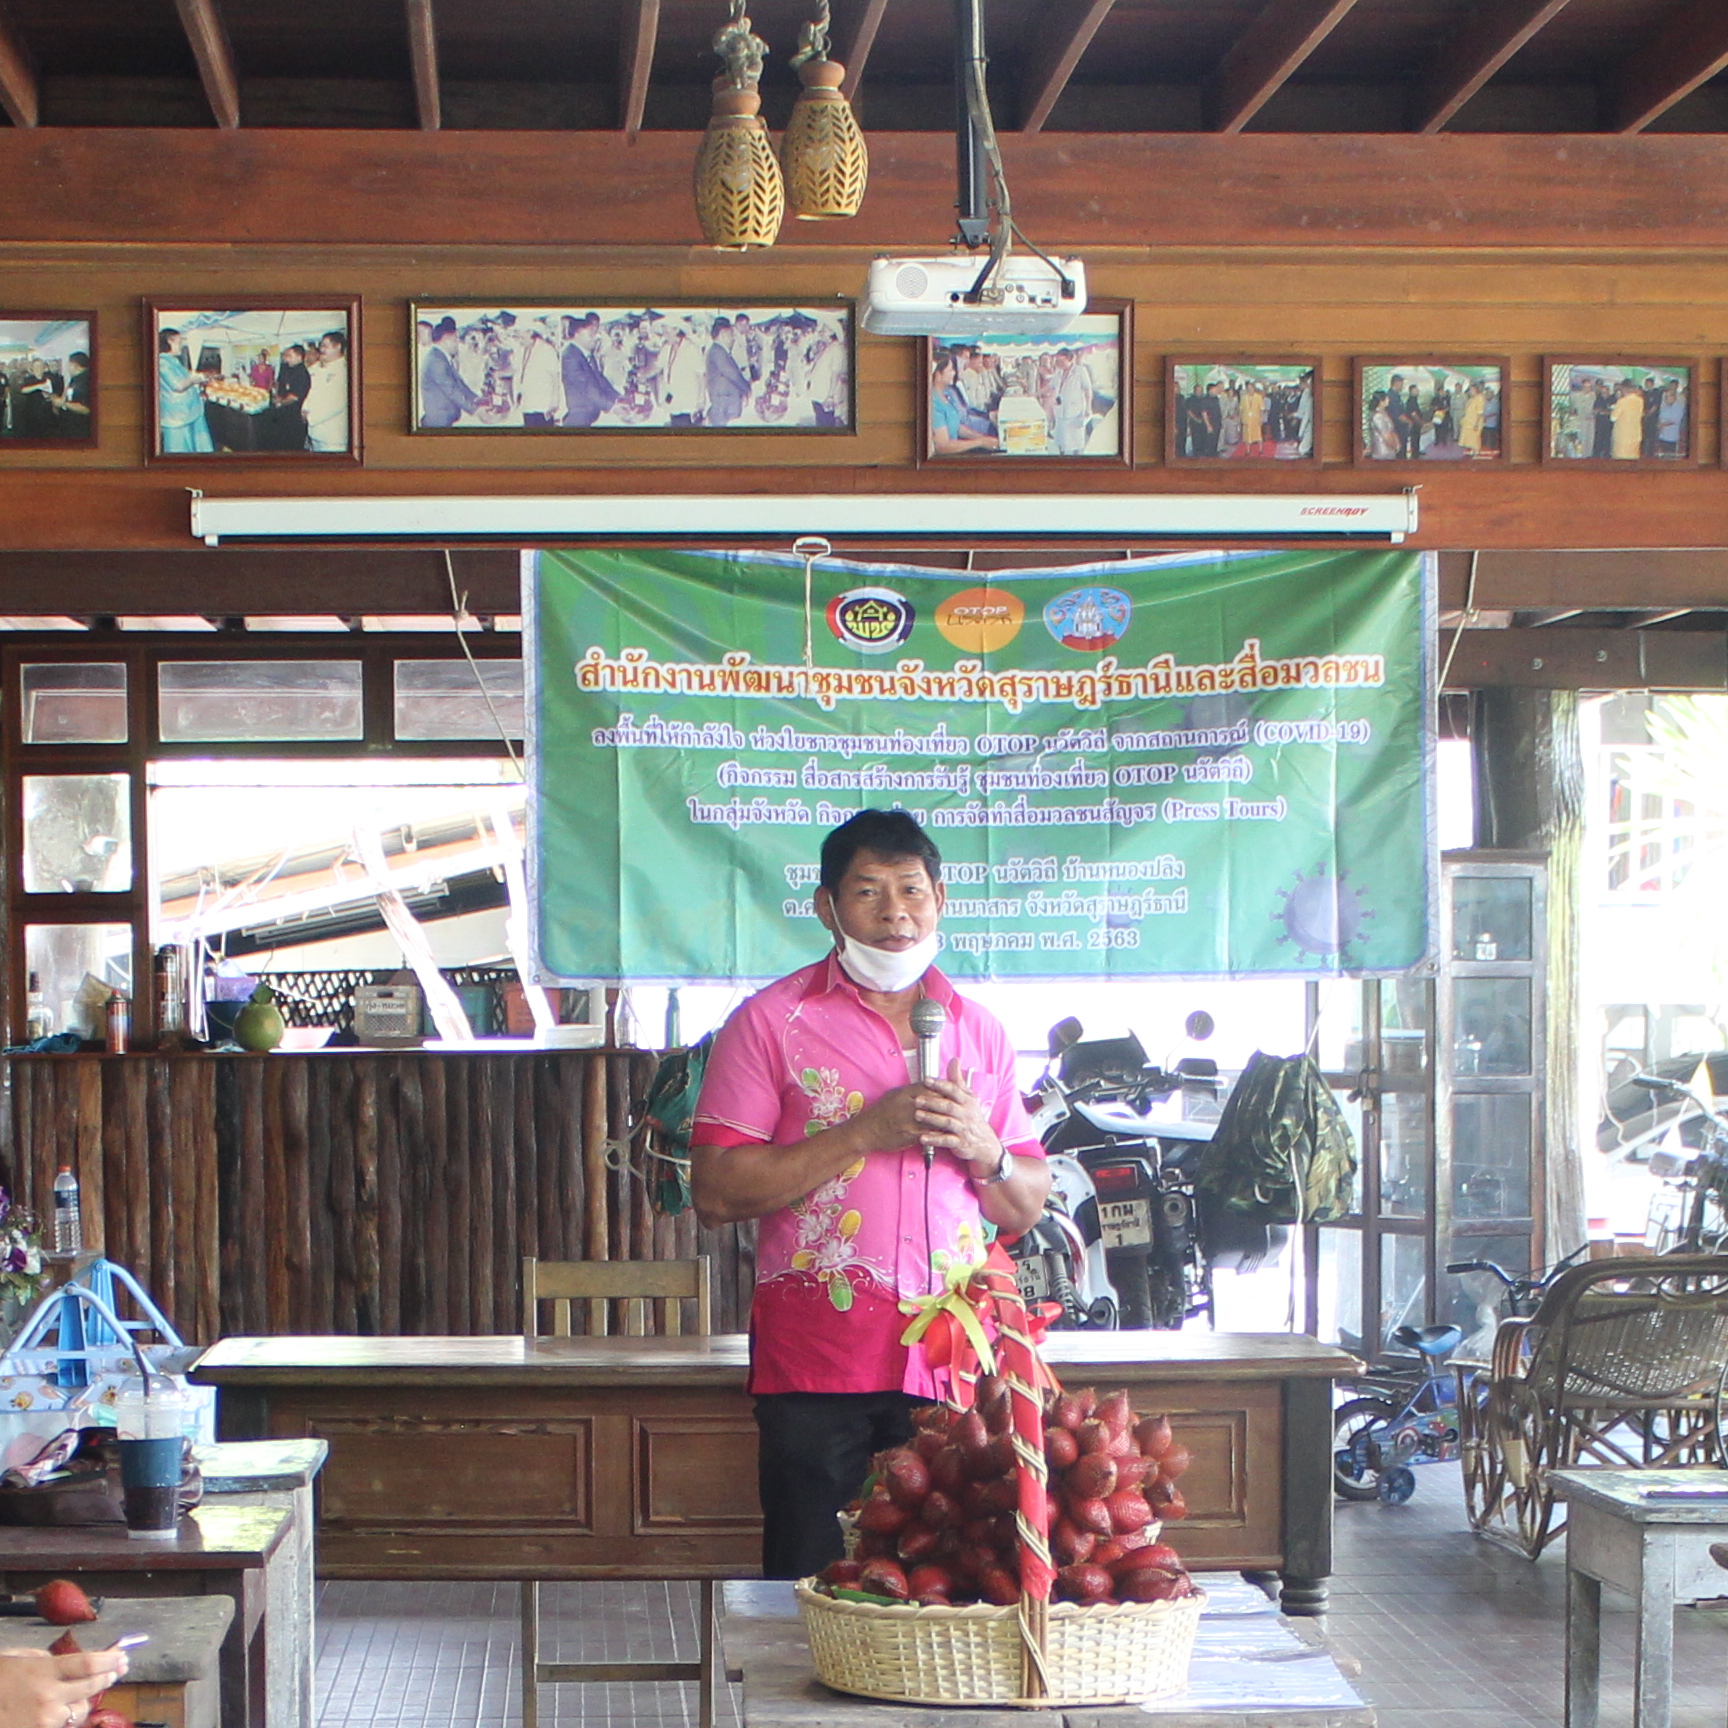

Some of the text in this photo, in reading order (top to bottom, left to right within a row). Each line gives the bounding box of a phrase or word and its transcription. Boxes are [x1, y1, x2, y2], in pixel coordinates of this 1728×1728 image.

[953, 605, 1008, 616] OTOP
[977, 738, 1037, 754] OTOP
[1254, 721, 1370, 745] (COVID-19)
[718, 763, 795, 788] (กิจกรรม
[1115, 767, 1177, 784] OTOP
[1164, 801, 1219, 821] (Press
[1227, 800, 1287, 820] Tours)
[1026, 891, 1188, 922] จังหวัดสุราษฎร์ธานี
[1087, 931, 1140, 949] 2563
